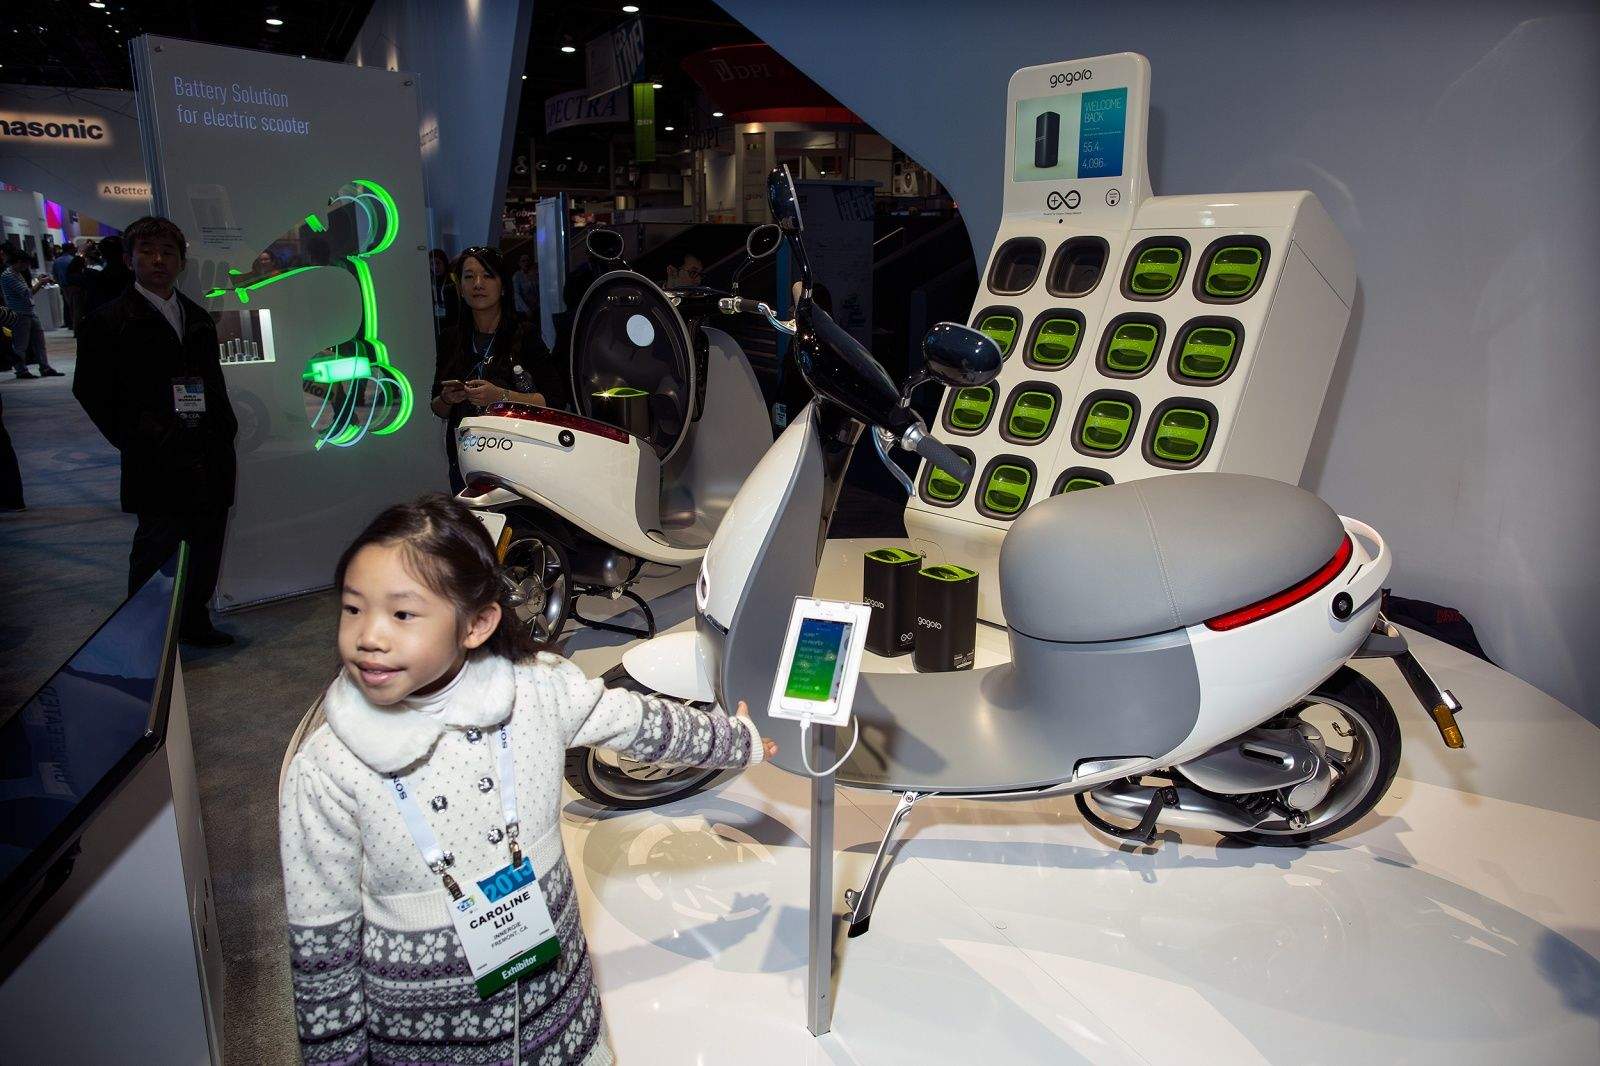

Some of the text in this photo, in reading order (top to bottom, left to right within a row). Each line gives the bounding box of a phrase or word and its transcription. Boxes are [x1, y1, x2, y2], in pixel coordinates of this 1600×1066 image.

[1050, 69, 1092, 88] gogoro
[174, 76, 289, 107] Battery Solution
[1085, 98, 1121, 111] WELCOME
[177, 104, 310, 134] for electric scooter
[1085, 112, 1104, 123] BACK
[104, 186, 148, 195] A Better
[469, 891, 531, 929] CAROLINE
[494, 912, 515, 929] LIU
[501, 955, 537, 980] Exhibitor
